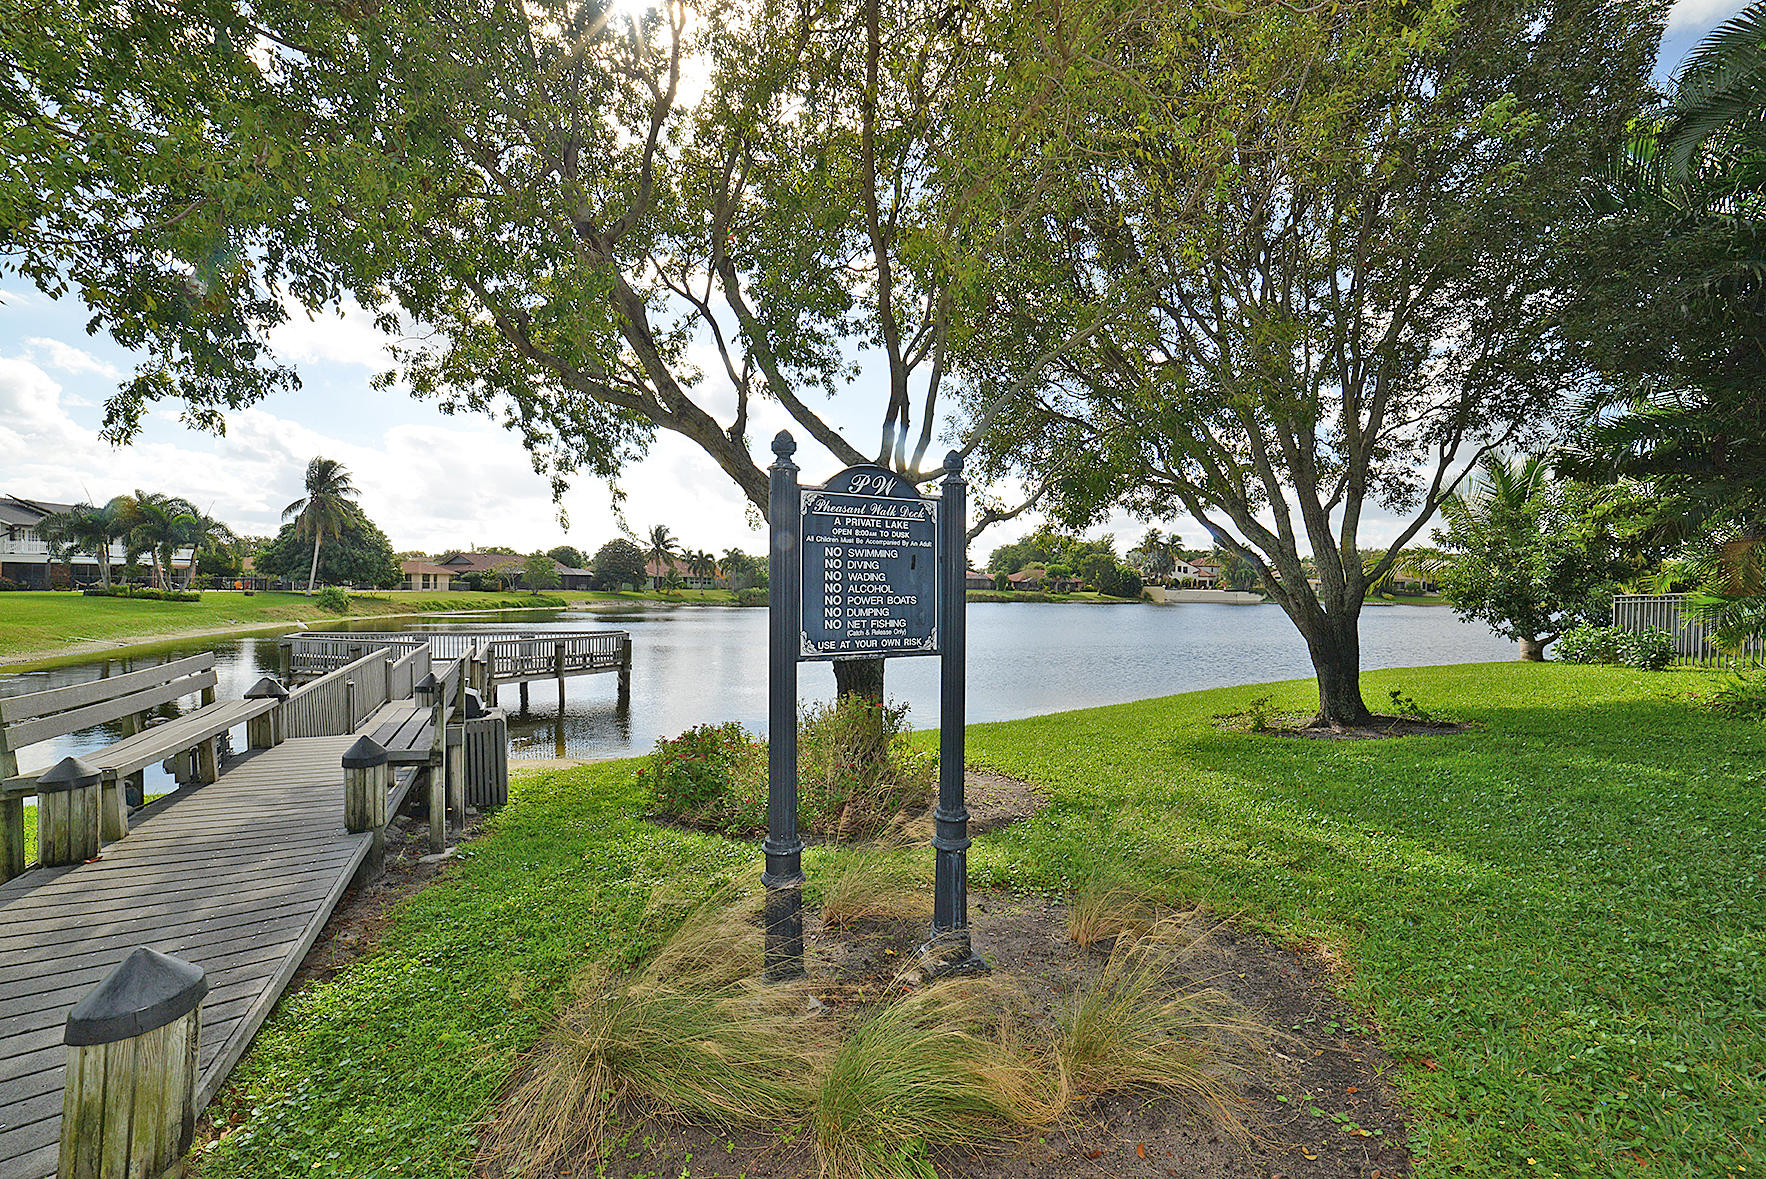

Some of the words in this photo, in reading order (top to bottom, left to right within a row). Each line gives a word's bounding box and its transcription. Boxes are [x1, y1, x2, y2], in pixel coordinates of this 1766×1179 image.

[813, 499, 866, 515] Pheasant
[870, 503, 896, 516] Walk
[900, 506, 925, 518] Dock
[846, 518, 881, 527] PRIVATE
[885, 520, 909, 529] LAKE
[866, 538, 900, 547] Accompanied
[824, 547, 842, 557] NO
[848, 548, 898, 559] SWIMMING
[824, 559, 842, 569] NO
[847, 561, 879, 570] DIVING
[824, 571, 842, 581] NO
[848, 573, 886, 581] WADING
[824, 583, 842, 593] NO
[848, 585, 893, 593] ALCOHOL
[824, 595, 842, 605] NO
[847, 596, 883, 605] POWER
[887, 596, 917, 604] BOATS
[824, 607, 842, 617] NO
[847, 608, 889, 617] DUMPING
[824, 619, 842, 629] NO
[847, 620, 867, 629] NET
[871, 619, 906, 628] FISHING
[818, 641, 835, 650] USE
[840, 641, 850, 649] AT
[855, 640, 877, 648] YOUR
[881, 639, 900, 647] OWN
[904, 638, 923, 646] RISK
